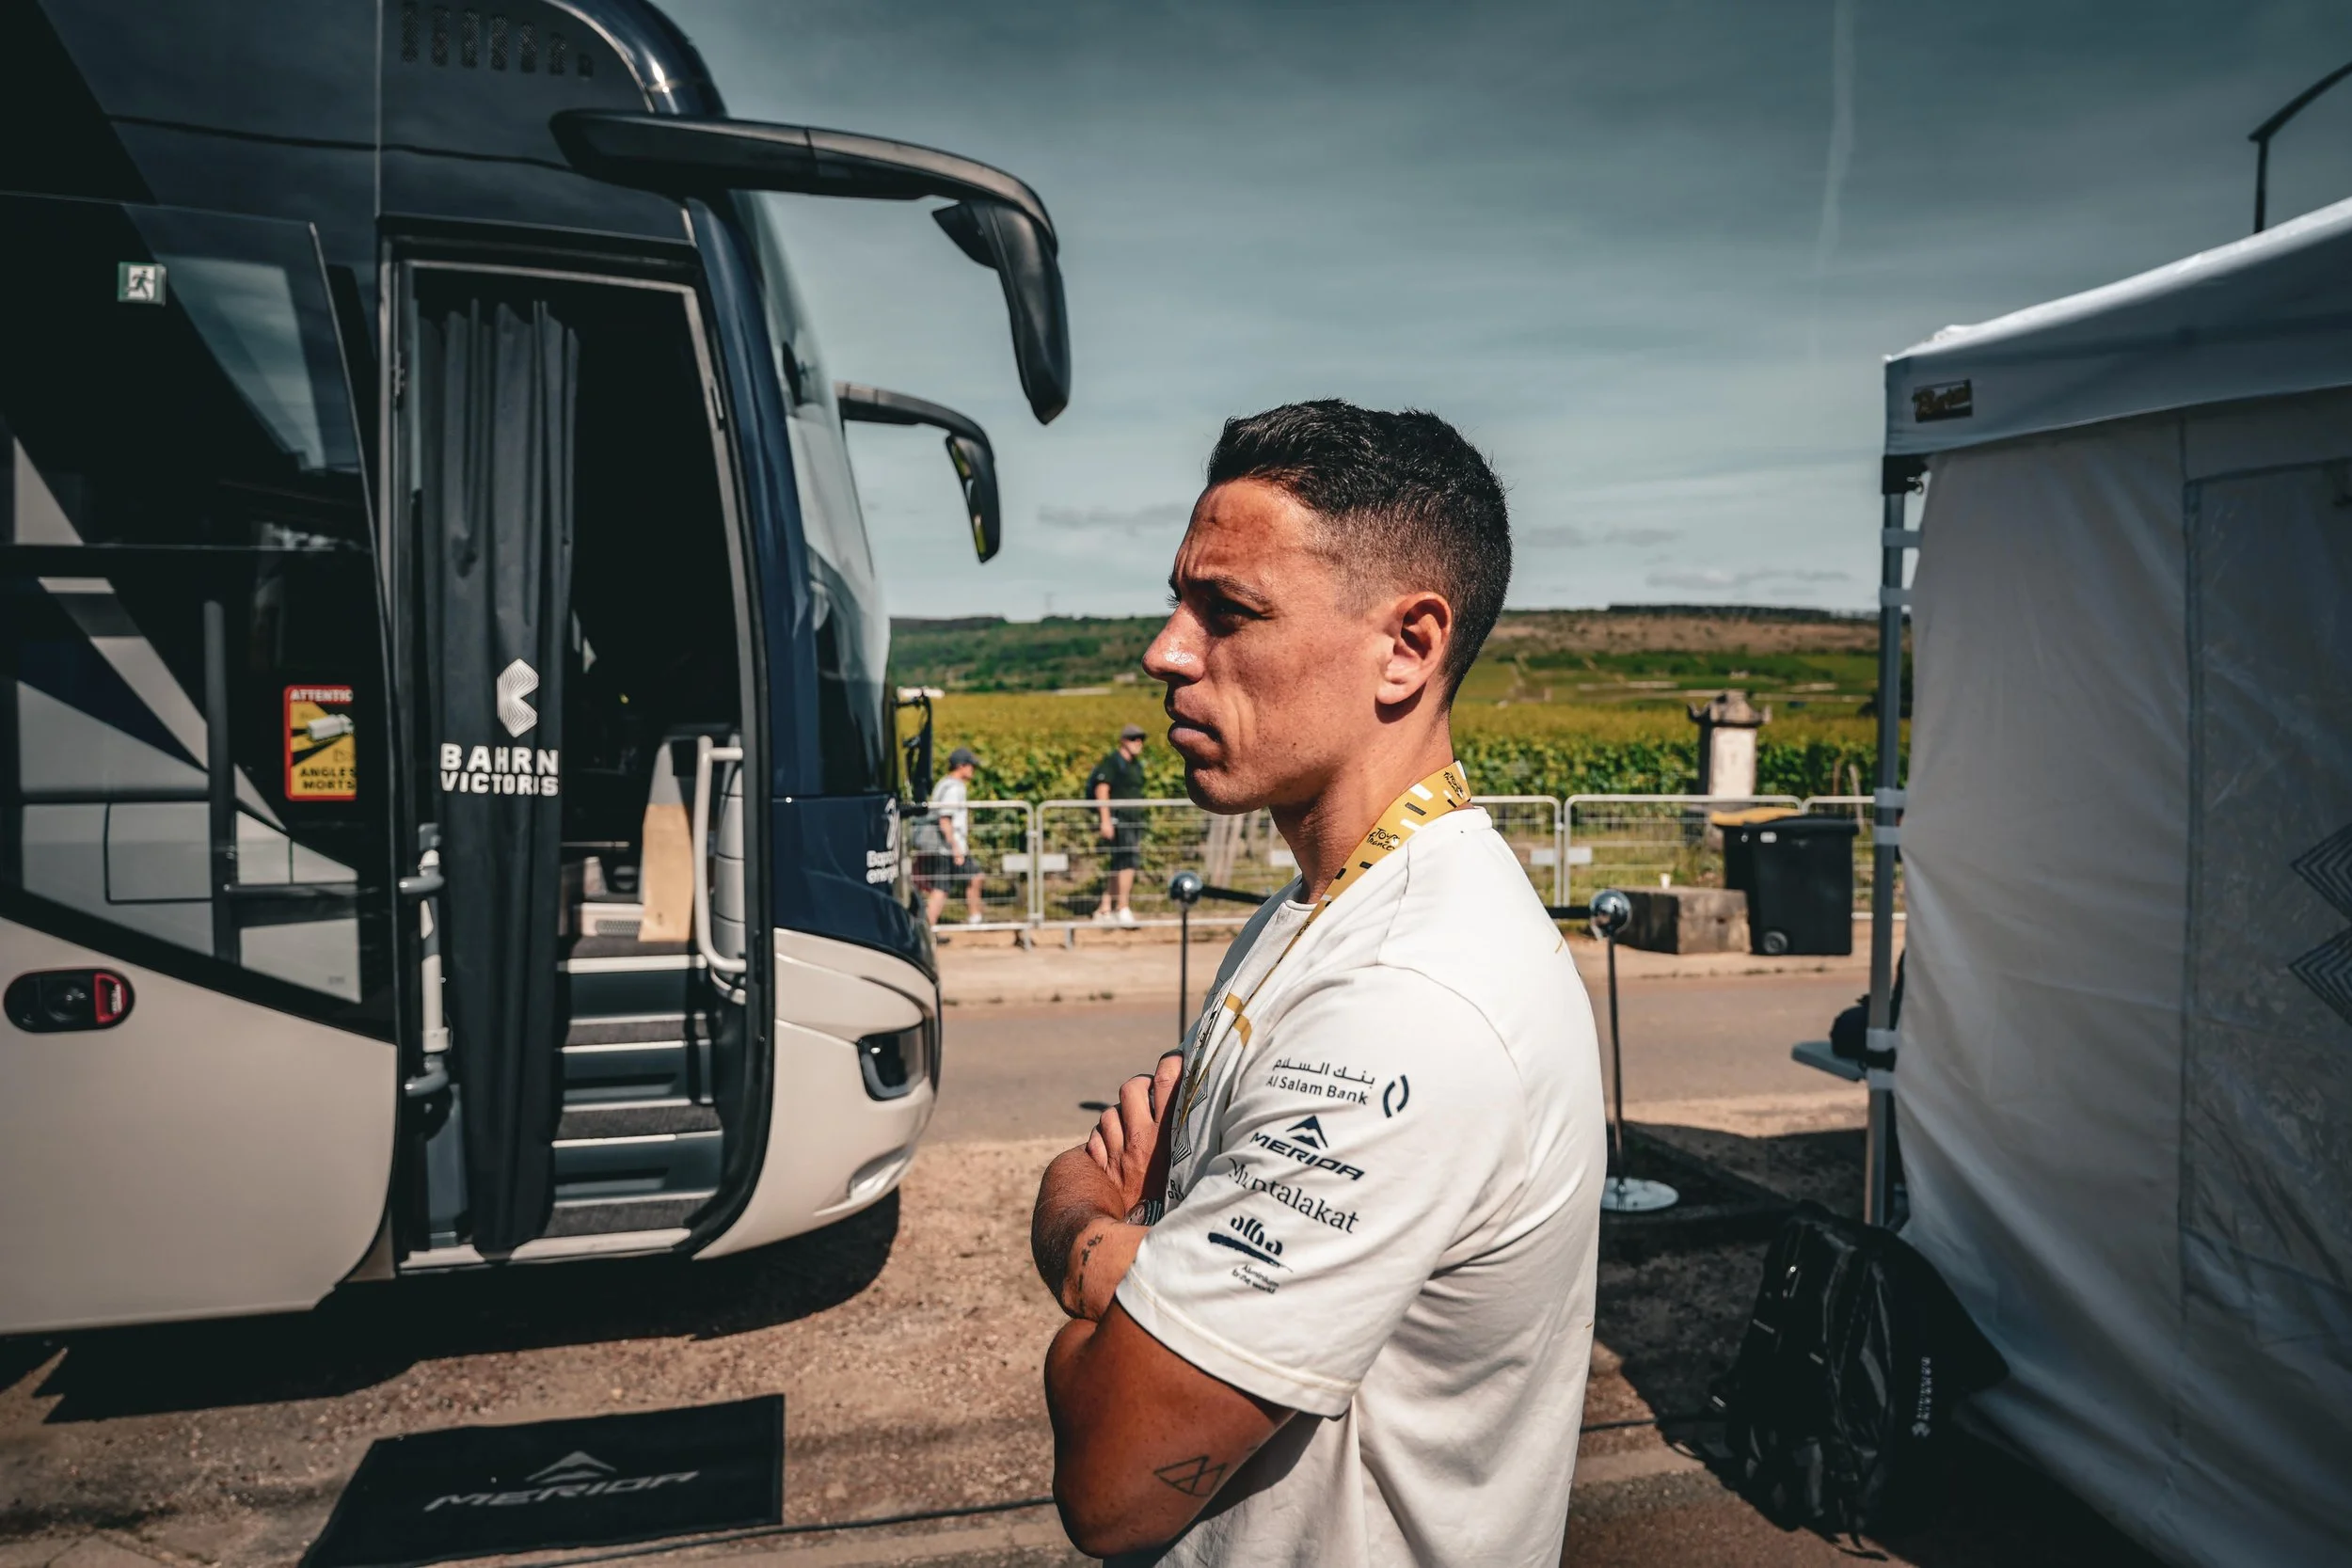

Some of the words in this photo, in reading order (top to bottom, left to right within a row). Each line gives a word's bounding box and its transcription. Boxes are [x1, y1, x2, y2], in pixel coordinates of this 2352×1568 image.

[1265, 1075, 1279, 1087] Al
[1279, 1076, 1322, 1096] Salam
[1327, 1085, 1369, 1105] Bank
[1249, 1132, 1365, 1181] MERIDA
[422, 1469, 700, 1512] MERIDA
